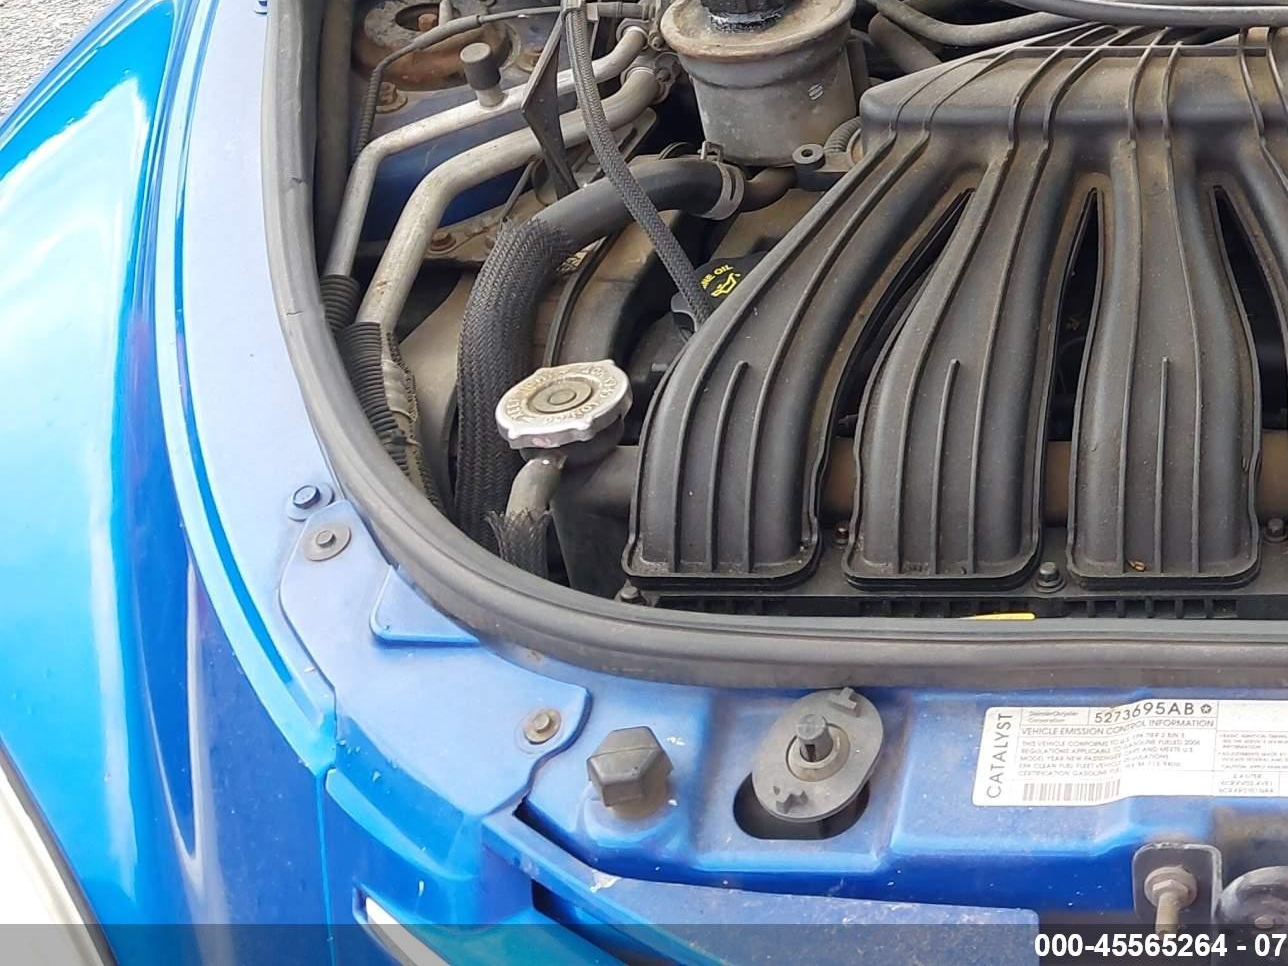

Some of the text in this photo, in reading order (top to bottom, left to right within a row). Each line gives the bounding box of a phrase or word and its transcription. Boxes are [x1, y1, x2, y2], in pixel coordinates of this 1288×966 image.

[713, 264, 734, 275] OIL
[1094, 701, 1195, 724] 5273695AB
[1021, 718, 1215, 736] VEHICLE EMISSION CONTROL INFORMATION
[985, 713, 1013, 799] CATALYST
